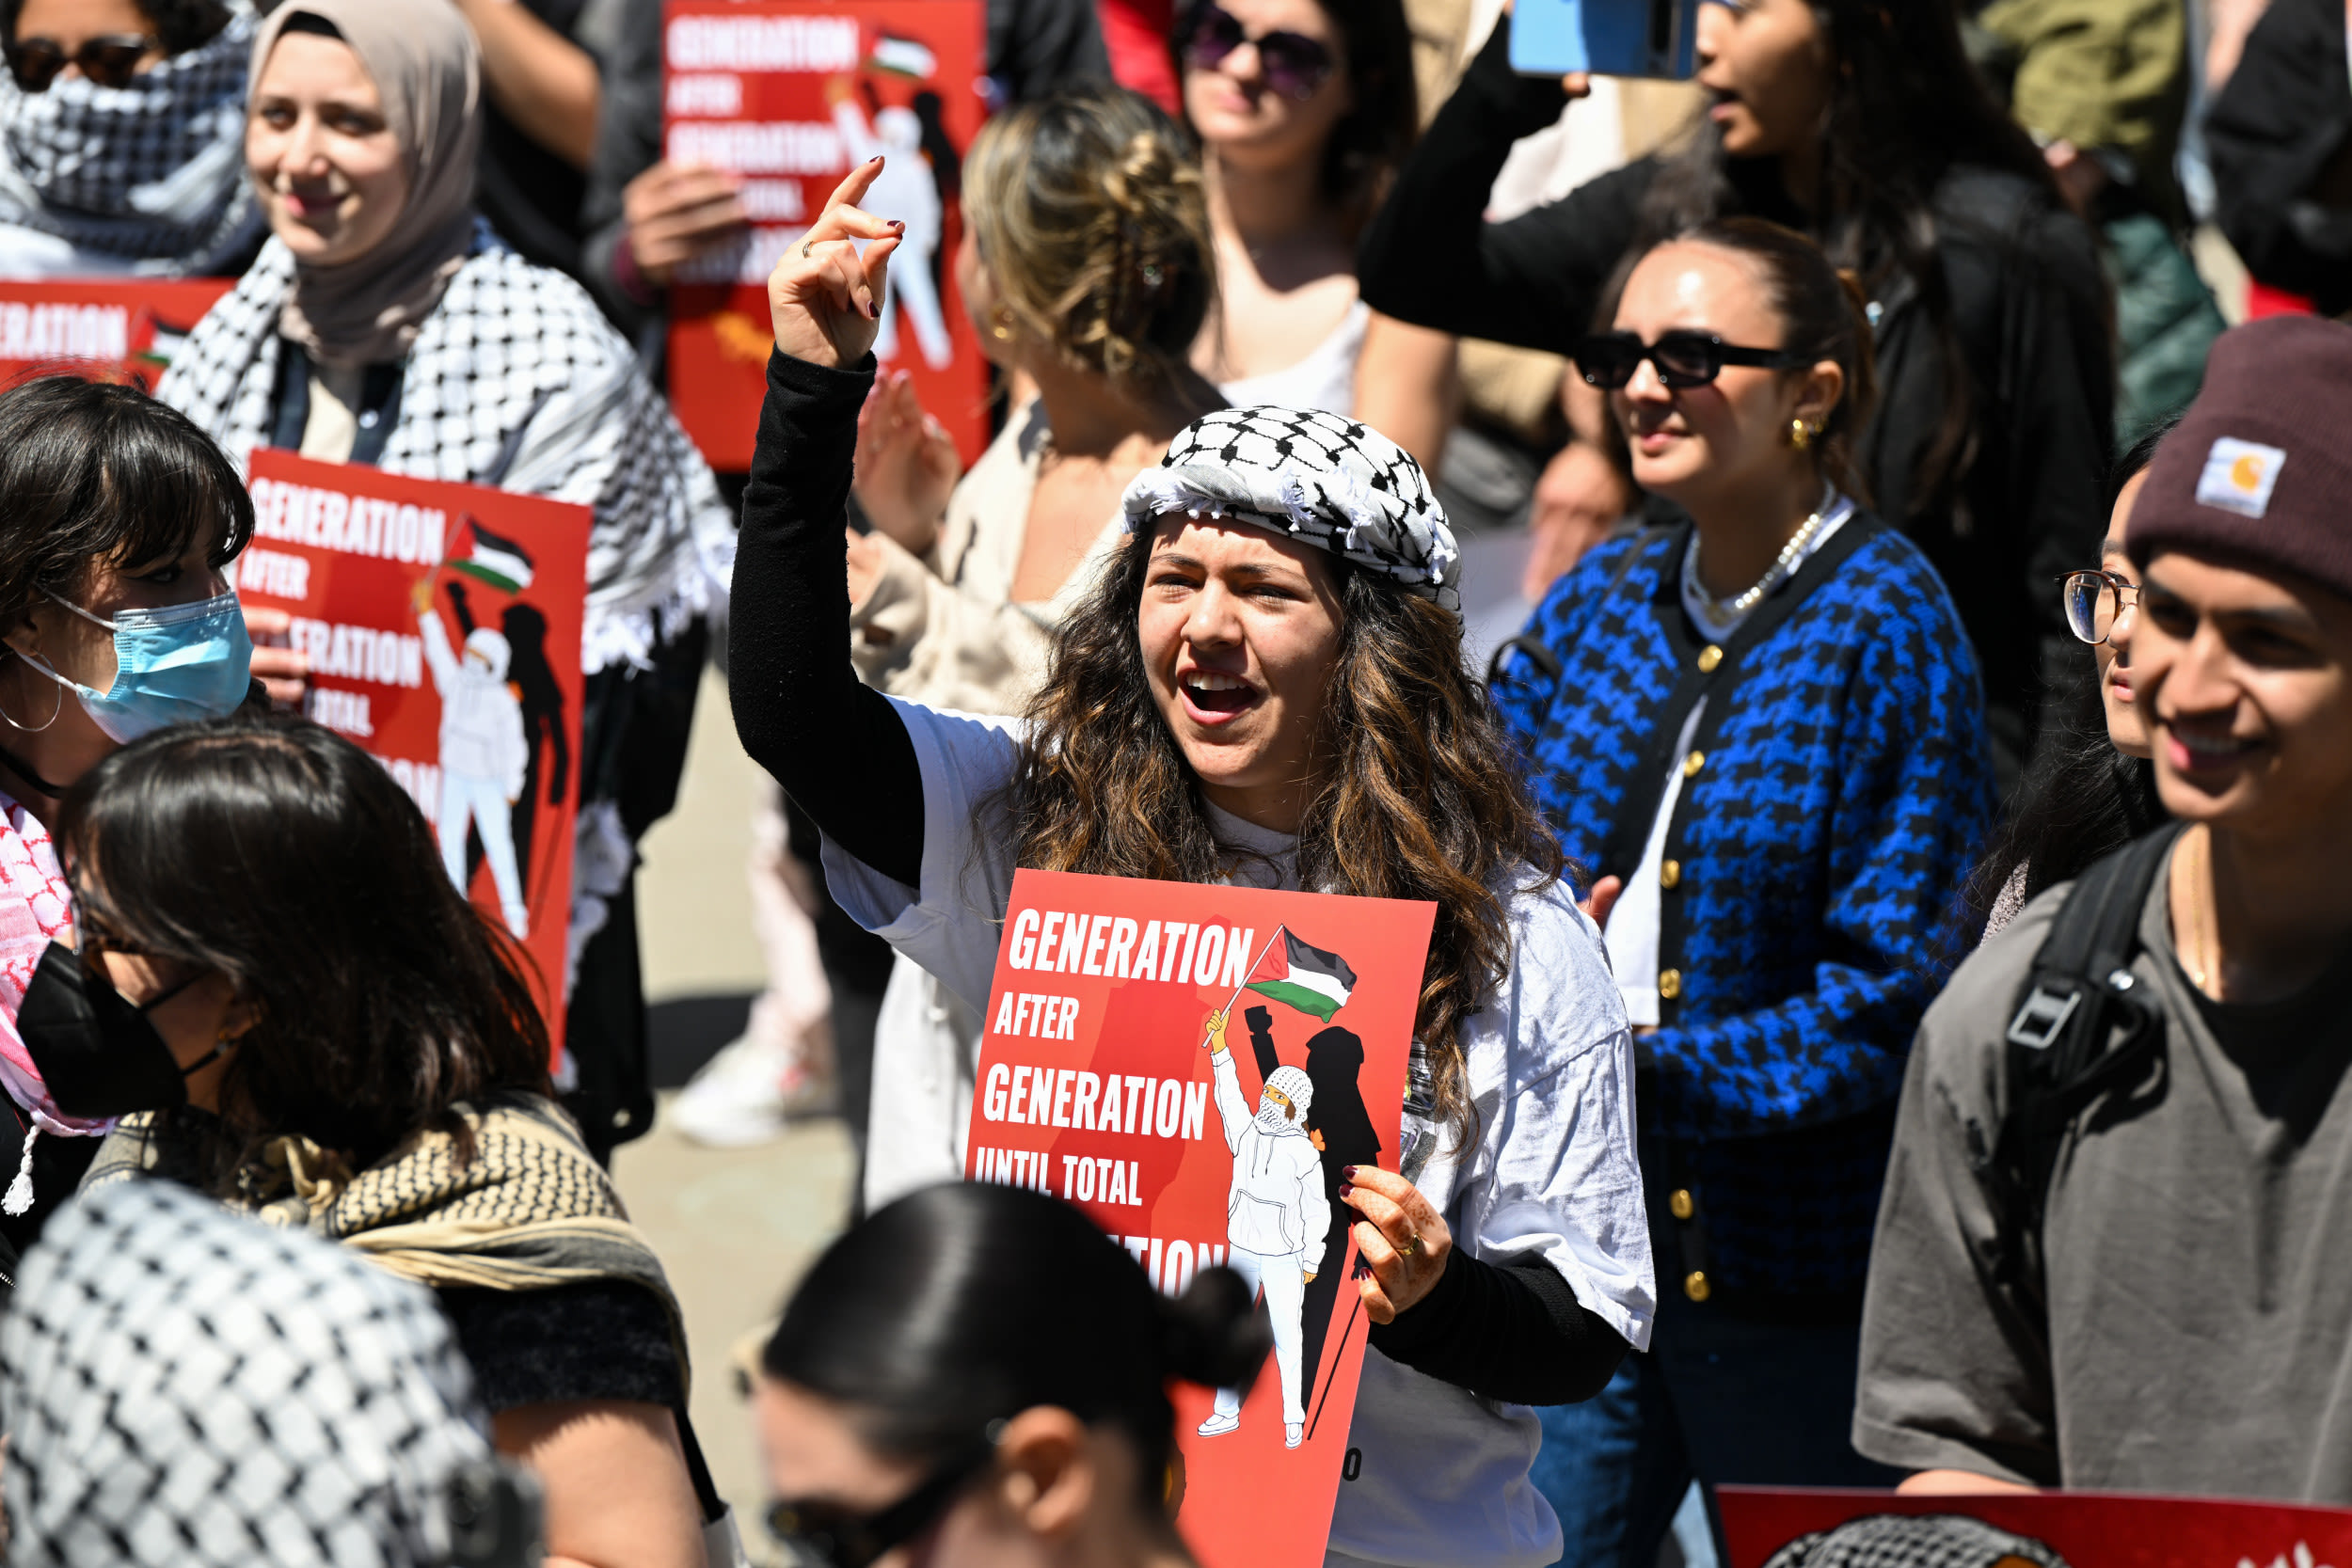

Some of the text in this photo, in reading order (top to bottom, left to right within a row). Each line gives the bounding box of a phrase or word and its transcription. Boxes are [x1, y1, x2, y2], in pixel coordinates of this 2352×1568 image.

[251, 477, 446, 567] GENERATION
[240, 548, 310, 600] AFTER
[1009, 909, 1254, 988] GENERATION
[993, 991, 1079, 1040] AFTER
[983, 1063, 1207, 1140] GENERATION
[1062, 1155, 1142, 1206] TOTAL
